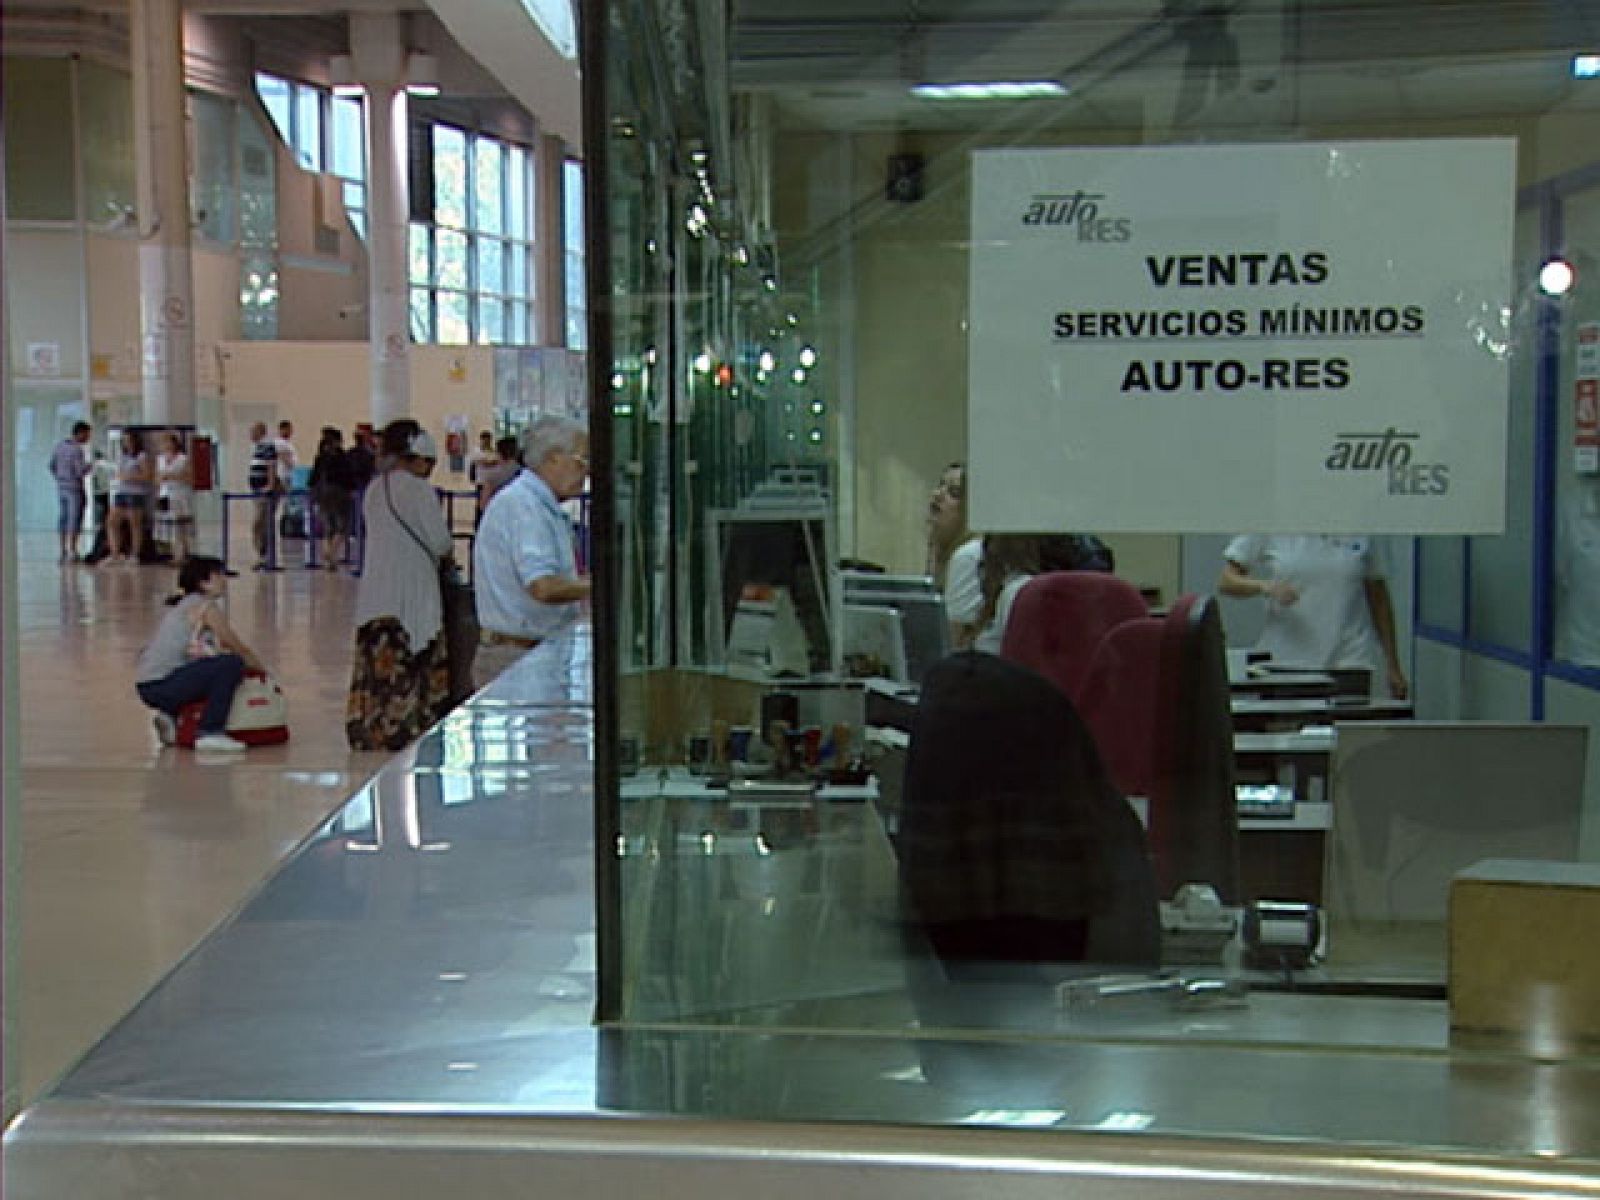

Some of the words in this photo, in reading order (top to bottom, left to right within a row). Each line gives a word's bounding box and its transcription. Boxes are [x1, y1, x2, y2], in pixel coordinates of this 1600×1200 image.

[1022, 190, 1105, 225] auto
[1078, 218, 1131, 243] RES
[1146, 252, 1329, 287] VENTAS
[1054, 310, 1247, 339] SERVICIOS
[1259, 302, 1424, 335] MÍNIMOS
[1121, 357, 1350, 392] AUTO-RES
[1325, 427, 1419, 470] auto
[1388, 464, 1449, 495] RES
